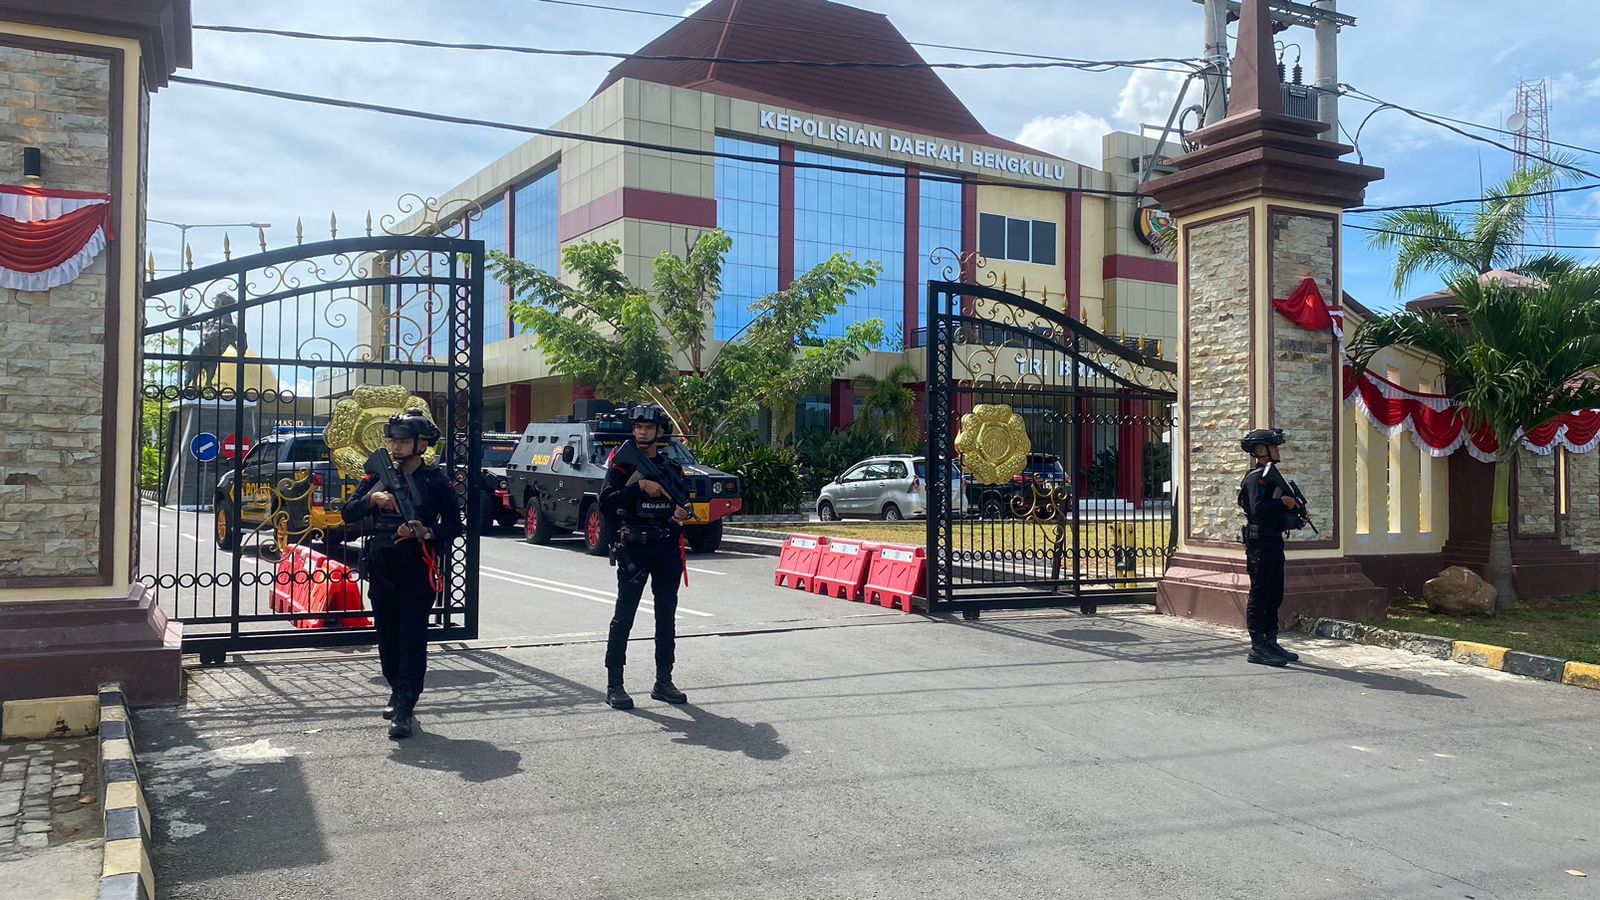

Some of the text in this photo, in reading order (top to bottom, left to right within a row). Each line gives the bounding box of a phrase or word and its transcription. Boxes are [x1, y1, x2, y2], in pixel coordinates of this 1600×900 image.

[760, 110, 1065, 181] KEPOLISIAN DAERAH BENGKULU
[1016, 357, 1048, 376] TRI
[275, 419, 304, 427] MASID
[531, 454, 551, 465] POLISI
